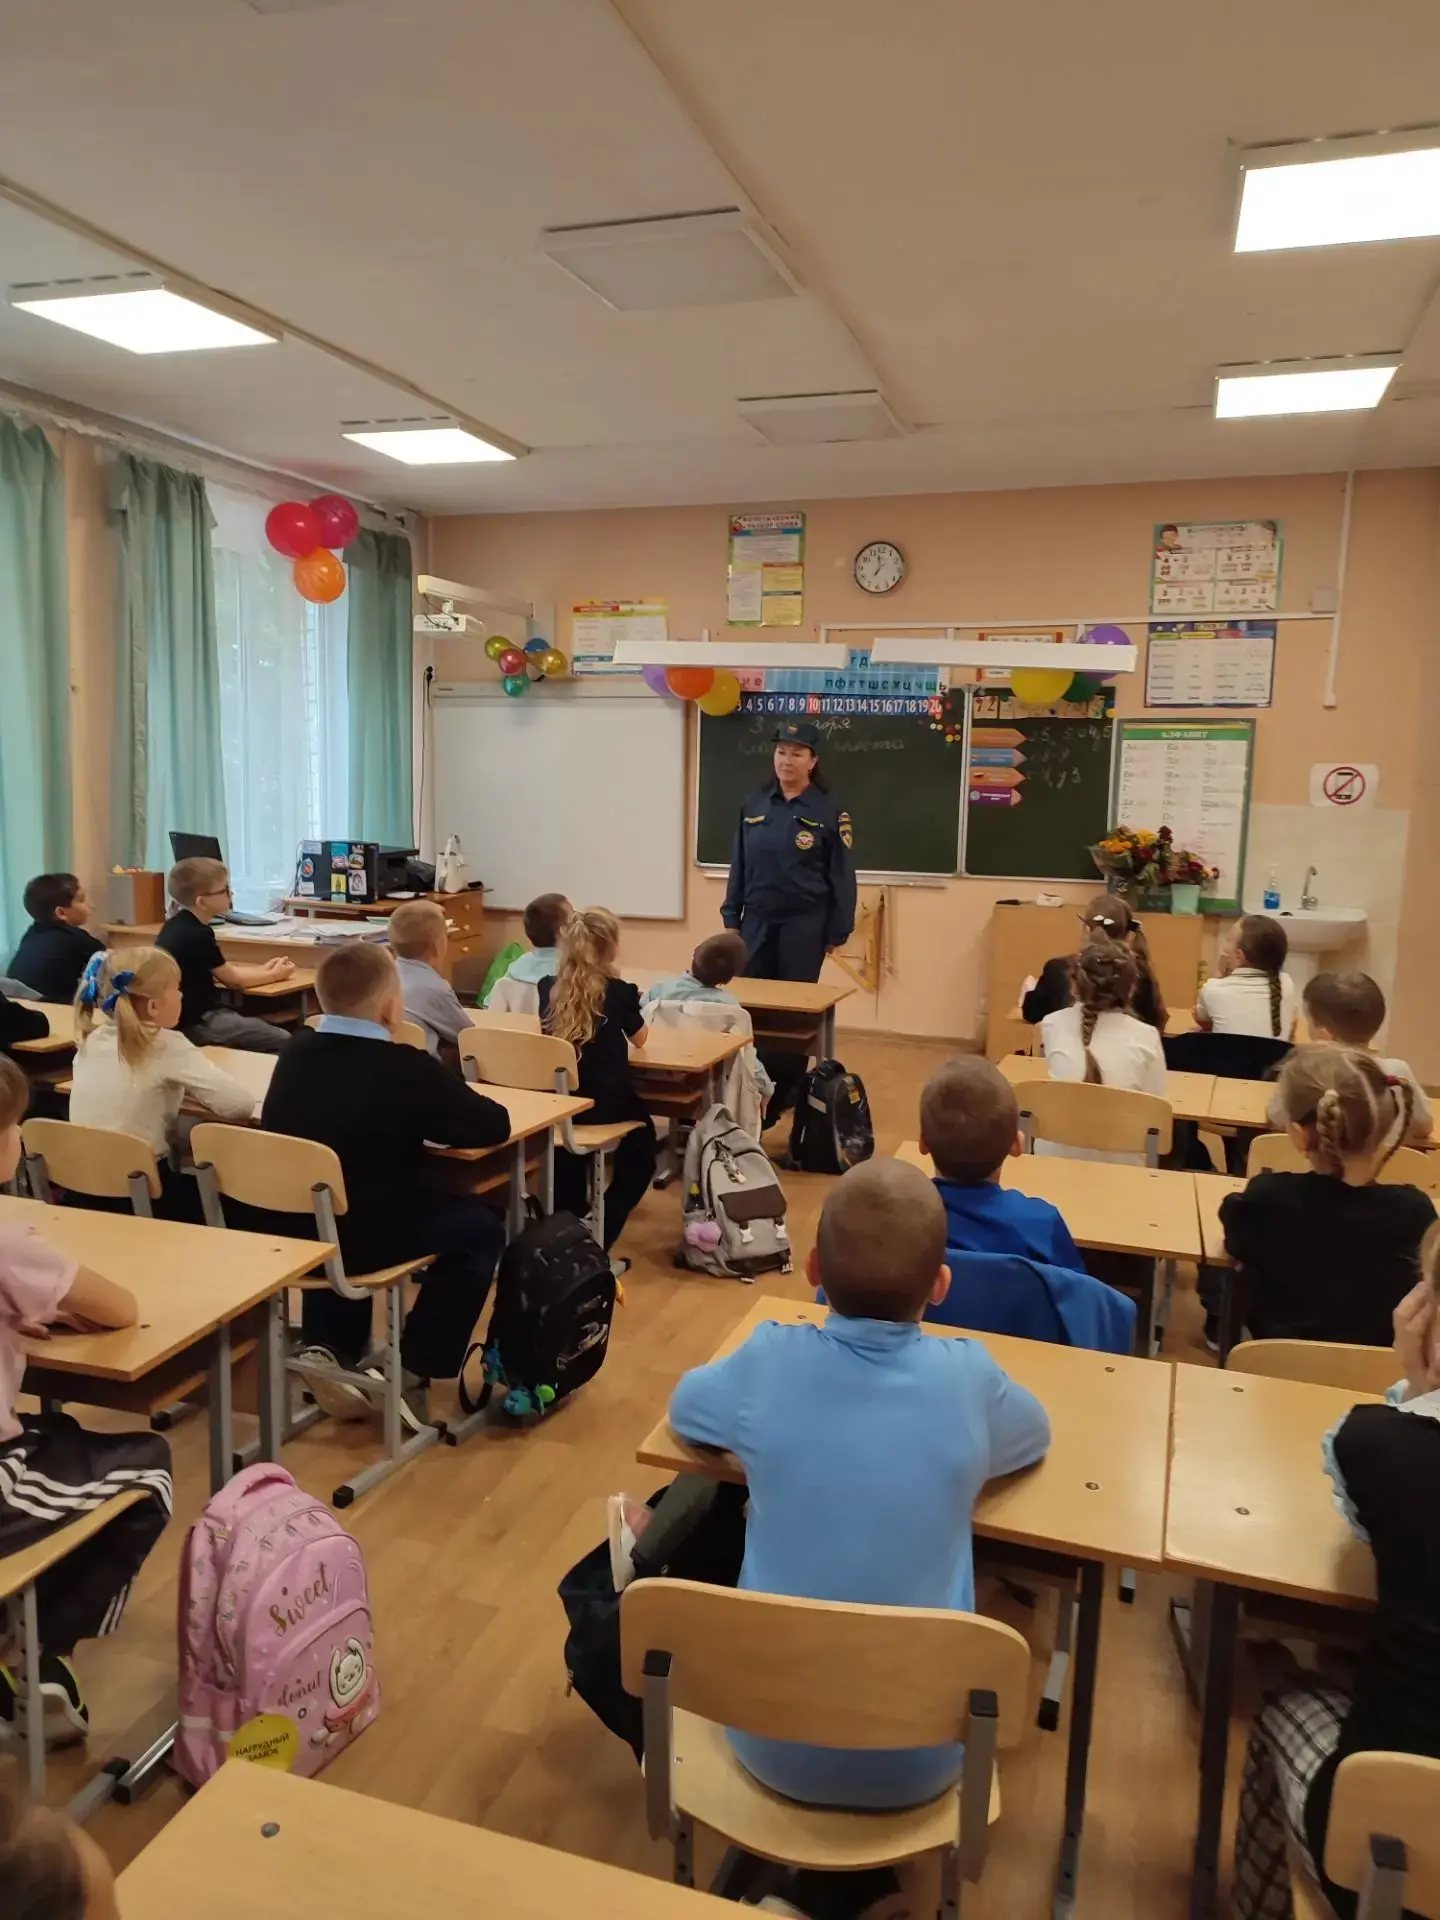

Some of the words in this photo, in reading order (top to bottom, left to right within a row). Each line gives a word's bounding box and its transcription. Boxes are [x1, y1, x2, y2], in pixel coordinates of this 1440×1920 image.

[746, 698, 753, 711] 4
[757, 698, 763, 711] 5
[767, 698, 775, 711] 6
[778, 698, 785, 711] 7
[788, 698, 796, 711] 8
[799, 698, 806, 711] 9
[808, 698, 819, 712] 10
[822, 698, 831, 712] 11
[833, 698, 843, 712] 12
[846, 699, 855, 712] 13
[857, 699, 868, 712] 14
[870, 700, 880, 713] 15
[882, 700, 892, 713] 16
[894, 700, 903, 713] 17
[906, 700, 916, 713] 18
[918, 700, 929, 713] 19
[269, 1562, 332, 1637] Sweet
[277, 1670, 321, 1708] donut
[235, 1732, 290, 1757] НАГРУДНЫЙ
